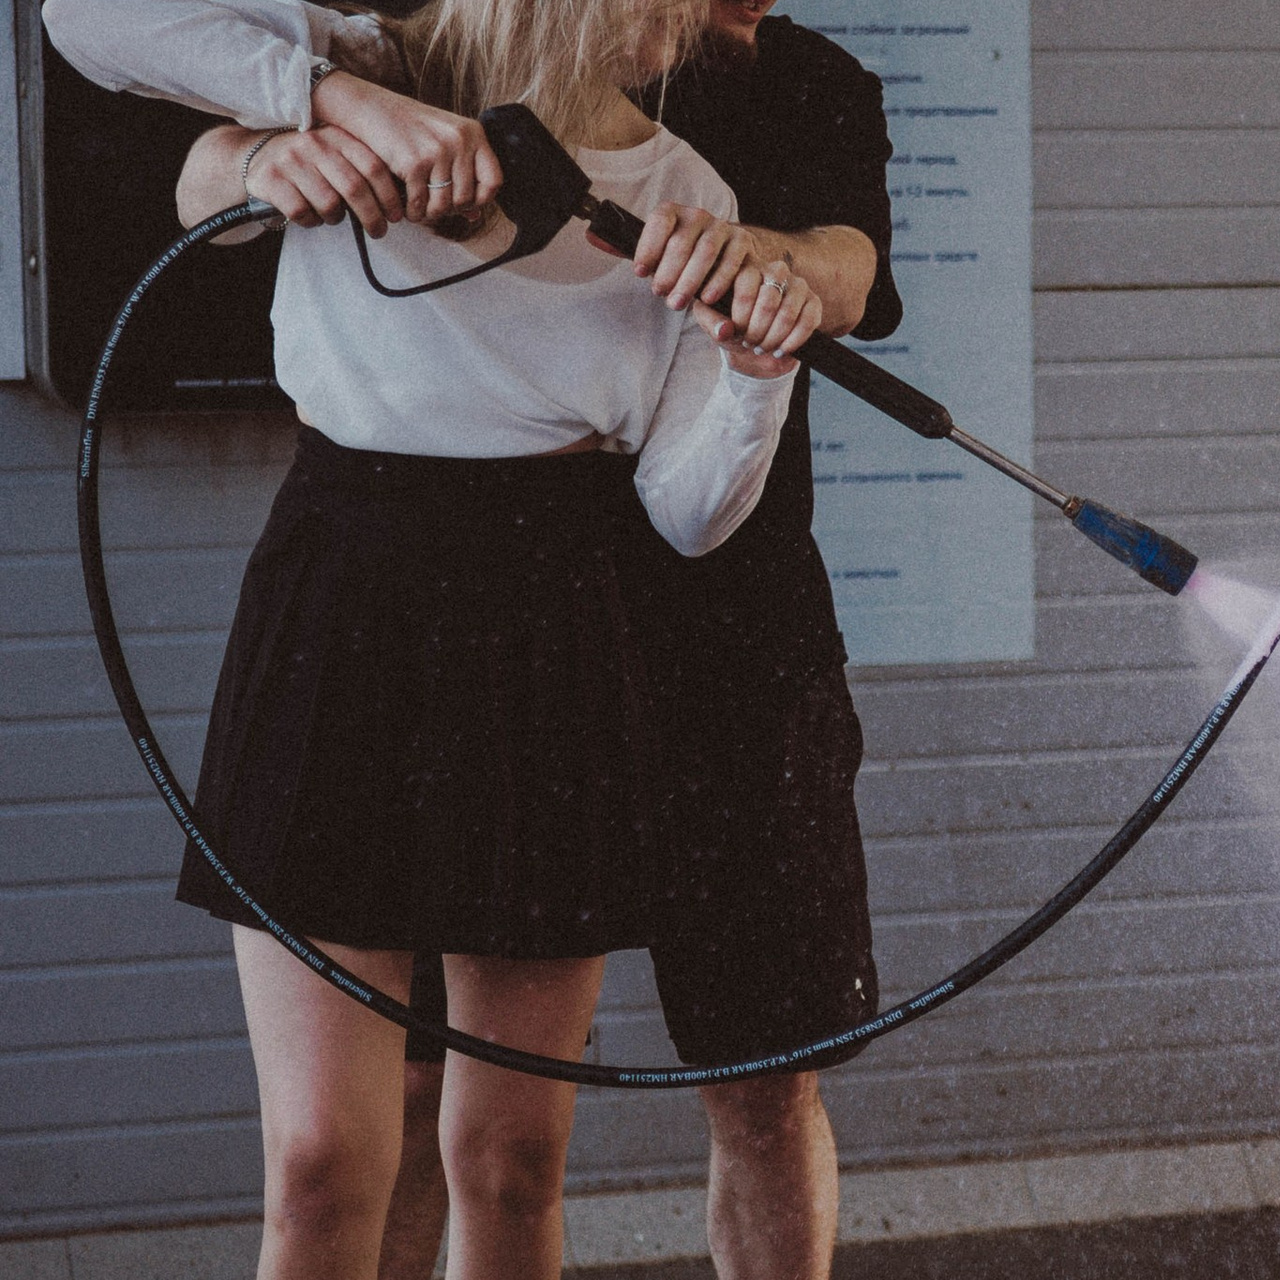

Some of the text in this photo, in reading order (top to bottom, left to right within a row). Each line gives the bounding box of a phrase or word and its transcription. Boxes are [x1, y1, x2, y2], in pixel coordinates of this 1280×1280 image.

[223, 205, 251, 223] HM25
[106, 327, 123, 348] 8mm
[100, 347, 114, 368] 2SN
[91, 368, 106, 400] EN853
[87, 400, 98, 420] DIN
[81, 428, 93, 478] Siberiaflex
[138, 737, 167, 784] HM251140
[1153, 761, 1188, 803] HM251140
[250, 901, 269, 921] 8mm
[266, 918, 285, 936] 2SN
[282, 933, 308, 957] EN853
[306, 953, 325, 970] DIN
[908, 980, 956, 1011] Siberiaflex
[885, 1010, 904, 1025] DIN
[835, 1032, 855, 1045] 2SN
[855, 1019, 884, 1038] EN853
[813, 1041, 836, 1052] 8mm
[619, 1073, 668, 1083] HM251140
